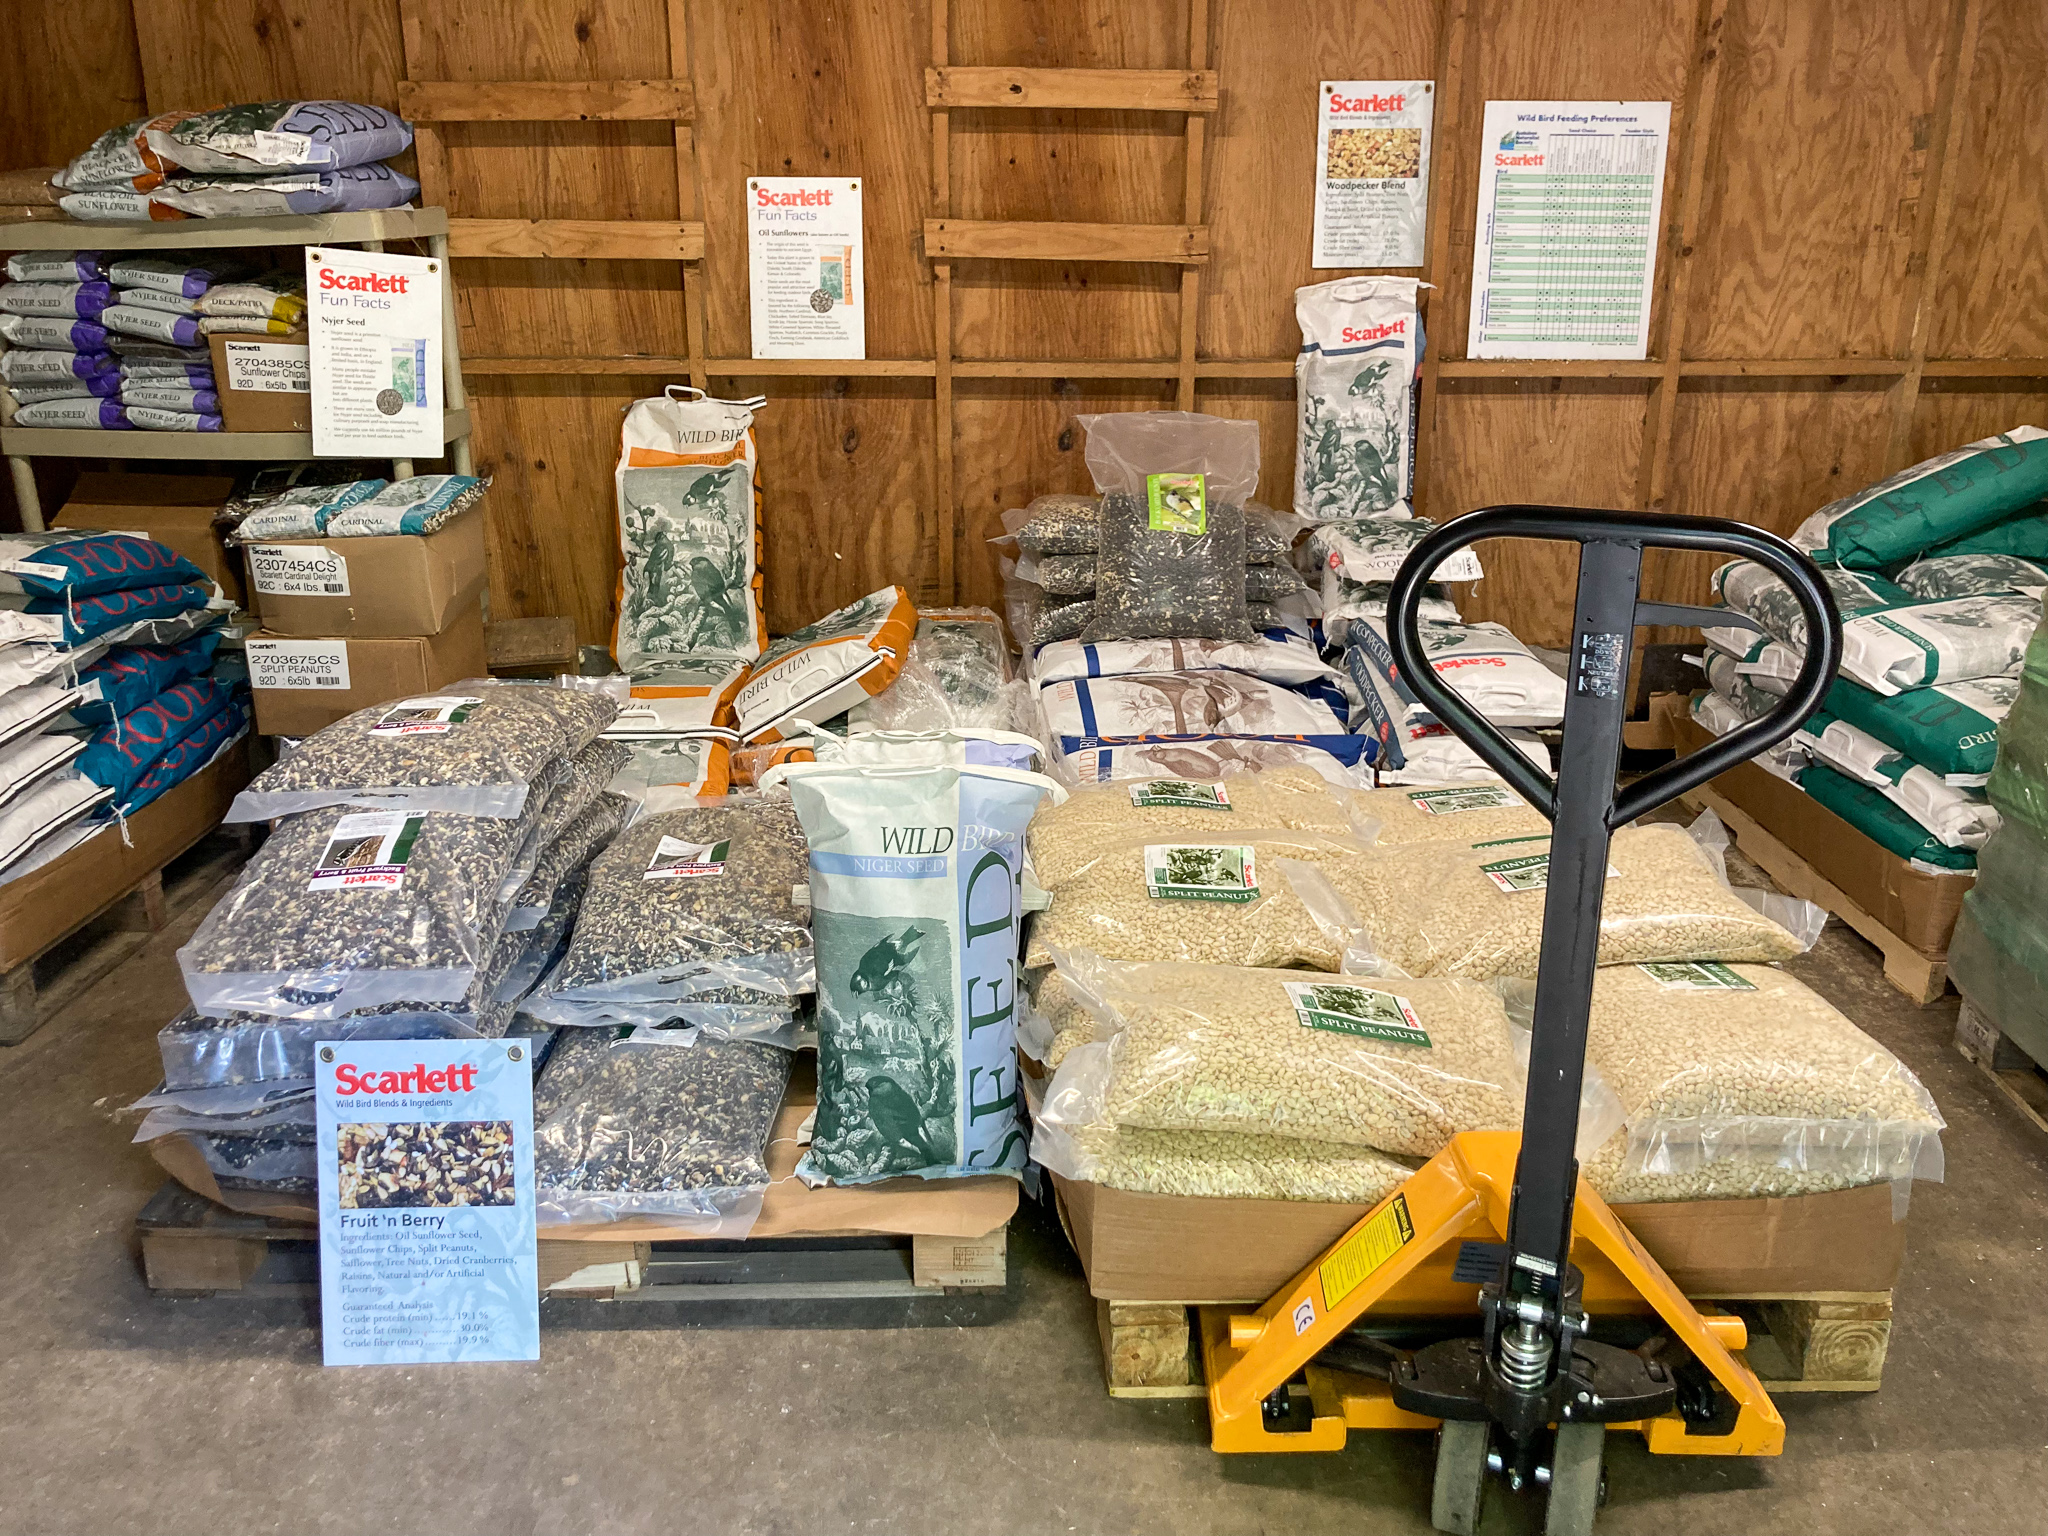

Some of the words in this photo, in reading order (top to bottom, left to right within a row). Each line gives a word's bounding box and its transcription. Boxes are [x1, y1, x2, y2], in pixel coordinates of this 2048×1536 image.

[1330, 94, 1406, 112] Scarlett
[1518, 114, 1536, 122] Wild
[1538, 114, 1555, 122] Bird
[1558, 114, 1588, 124] Feeding
[1495, 154, 1544, 166] Scarlett
[80, 161, 136, 182] SUNFLOWER
[1326, 182, 1378, 191] Woodpecker
[1381, 182, 1406, 190] Blend
[757, 188, 833, 206] Scarlett
[78, 200, 140, 212] SUNFLOWER
[758, 210, 781, 220] Fun
[785, 210, 818, 220] Facts
[147, 275, 168, 284] SEED
[320, 268, 409, 294] Scarlett
[131, 291, 157, 300] NYJER
[320, 292, 348, 306] Fun
[353, 295, 390, 309] Facts
[212, 298, 262, 307] DECK/PATIO
[114, 313, 138, 324] NYJER
[140, 319, 161, 328] SEED
[322, 316, 344, 326] Nyjer
[346, 318, 366, 326] Seed
[1342, 319, 1406, 343] Scarlett
[228, 344, 260, 352] Scarlett
[11, 364, 35, 372] NYJER
[241, 366, 280, 378] Sunflower
[282, 368, 306, 380] Chips
[237, 380, 254, 388] 92D
[266, 380, 287, 390] 6x5lb
[30, 410, 59, 419] NYJER
[62, 410, 86, 418] SEED
[138, 410, 164, 420] NYJER
[677, 430, 716, 444] WILD
[252, 515, 300, 525] CARDINAL
[341, 518, 384, 526] CARDINAL
[252, 547, 282, 556] Scarlett
[256, 558, 337, 572] 2307454CS
[260, 572, 284, 580] Scarlett
[284, 572, 312, 580] Cardinal
[313, 572, 338, 582] Delight
[258, 580, 276, 590] 92C
[284, 582, 300, 591] 6x4
[304, 582, 322, 592] lbs.
[1854, 620, 1889, 638] WILD
[252, 656, 340, 665] 2703675CS
[1433, 658, 1507, 672] Scarlet
[260, 666, 284, 674] SPLIT
[288, 666, 332, 674] PEANUTS
[773, 652, 812, 682] WILD
[259, 676, 276, 686] 92D
[288, 676, 310, 686] 6x5lb
[400, 725, 446, 734] Scarlett
[1958, 730, 1998, 750] IRD
[881, 826, 954, 854] WILD
[854, 859, 903, 874] NIGER
[906, 859, 945, 874] SEED
[1485, 856, 1542, 871] PEANUTS
[342, 874, 398, 885] Scarlett
[1202, 890, 1260, 900] PEANUTS
[966, 849, 1028, 1170] SEED
[1321, 1018, 1356, 1030] SPLIT
[1360, 1026, 1425, 1041] PEANUTS
[335, 1063, 478, 1096] Scarlett
[336, 1100, 354, 1108] Wild
[356, 1100, 372, 1108] Bird
[374, 1099, 400, 1108] Blends
[402, 1099, 408, 1107] &
[410, 1098, 452, 1109] Ingredients
[341, 1214, 378, 1228] Fruit
[402, 1214, 444, 1230] Berry
[340, 1232, 392, 1244] Ingredients:
[395, 1231, 410, 1240] Oil
[412, 1230, 456, 1240] Sunflower
[459, 1230, 482, 1240] Seed,
[340, 1246, 385, 1255] Sunflower
[388, 1244, 416, 1256] Chips,
[418, 1244, 438, 1256] Split
[440, 1244, 477, 1253] Peanuts,
[386, 1257, 405, 1266] Tree
[408, 1257, 432, 1267] Nuts,
[434, 1256, 460, 1266] Dried
[462, 1256, 517, 1266] Cranberries,
[342, 1272, 376, 1281] Raisins,
[378, 1270, 410, 1280] Natural
[413, 1269, 444, 1279] and/or
[446, 1268, 484, 1278] Artificial
[342, 1302, 394, 1311] Guaranteed
[398, 1301, 434, 1312] Analysis
[343, 1314, 370, 1324] Crude
[374, 1313, 406, 1325] protein
[344, 1326, 370, 1336] Crude
[374, 1325, 384, 1335] fat
[344, 1338, 371, 1348] Crude
[374, 1338, 394, 1348] fiber
